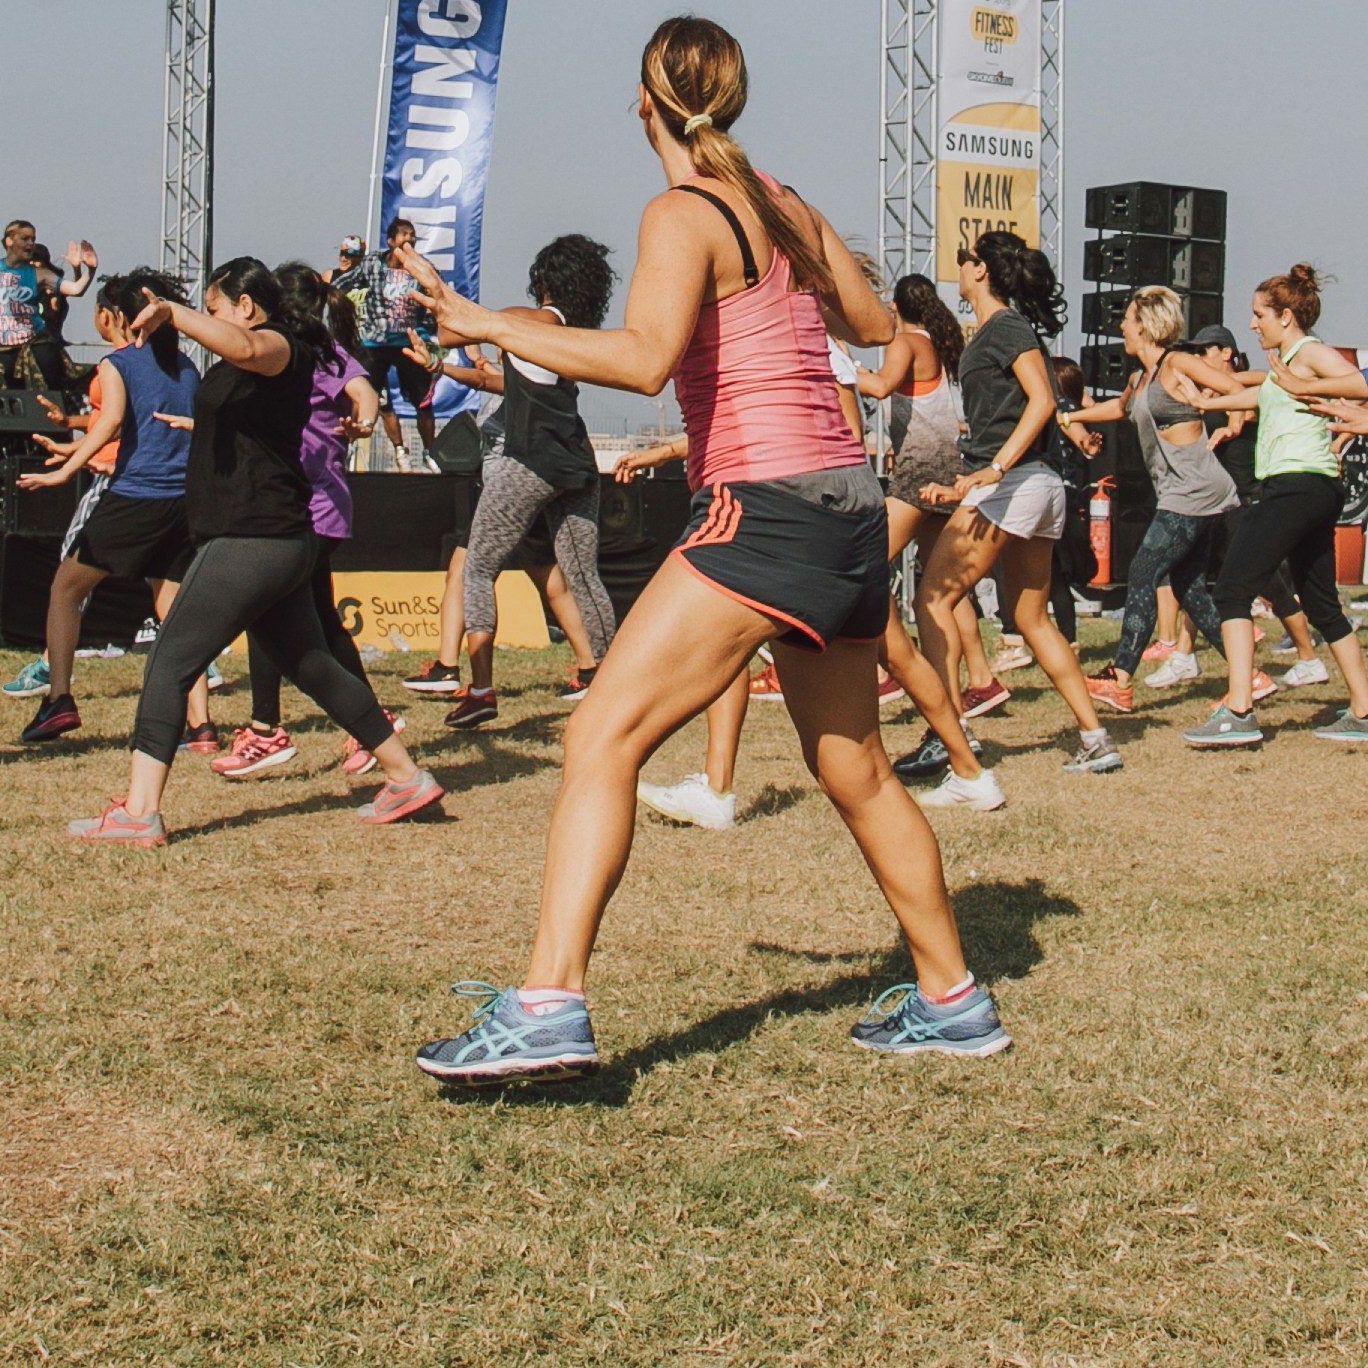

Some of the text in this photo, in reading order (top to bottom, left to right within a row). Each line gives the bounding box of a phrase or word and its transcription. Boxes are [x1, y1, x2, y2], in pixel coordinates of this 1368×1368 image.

[975, 11, 1014, 38] FITNESS
[984, 36, 1004, 55] FEST
[945, 131, 1034, 160] SAMSUNG
[964, 170, 1014, 211] MAIN
[371, 596, 440, 615] Sun&S
